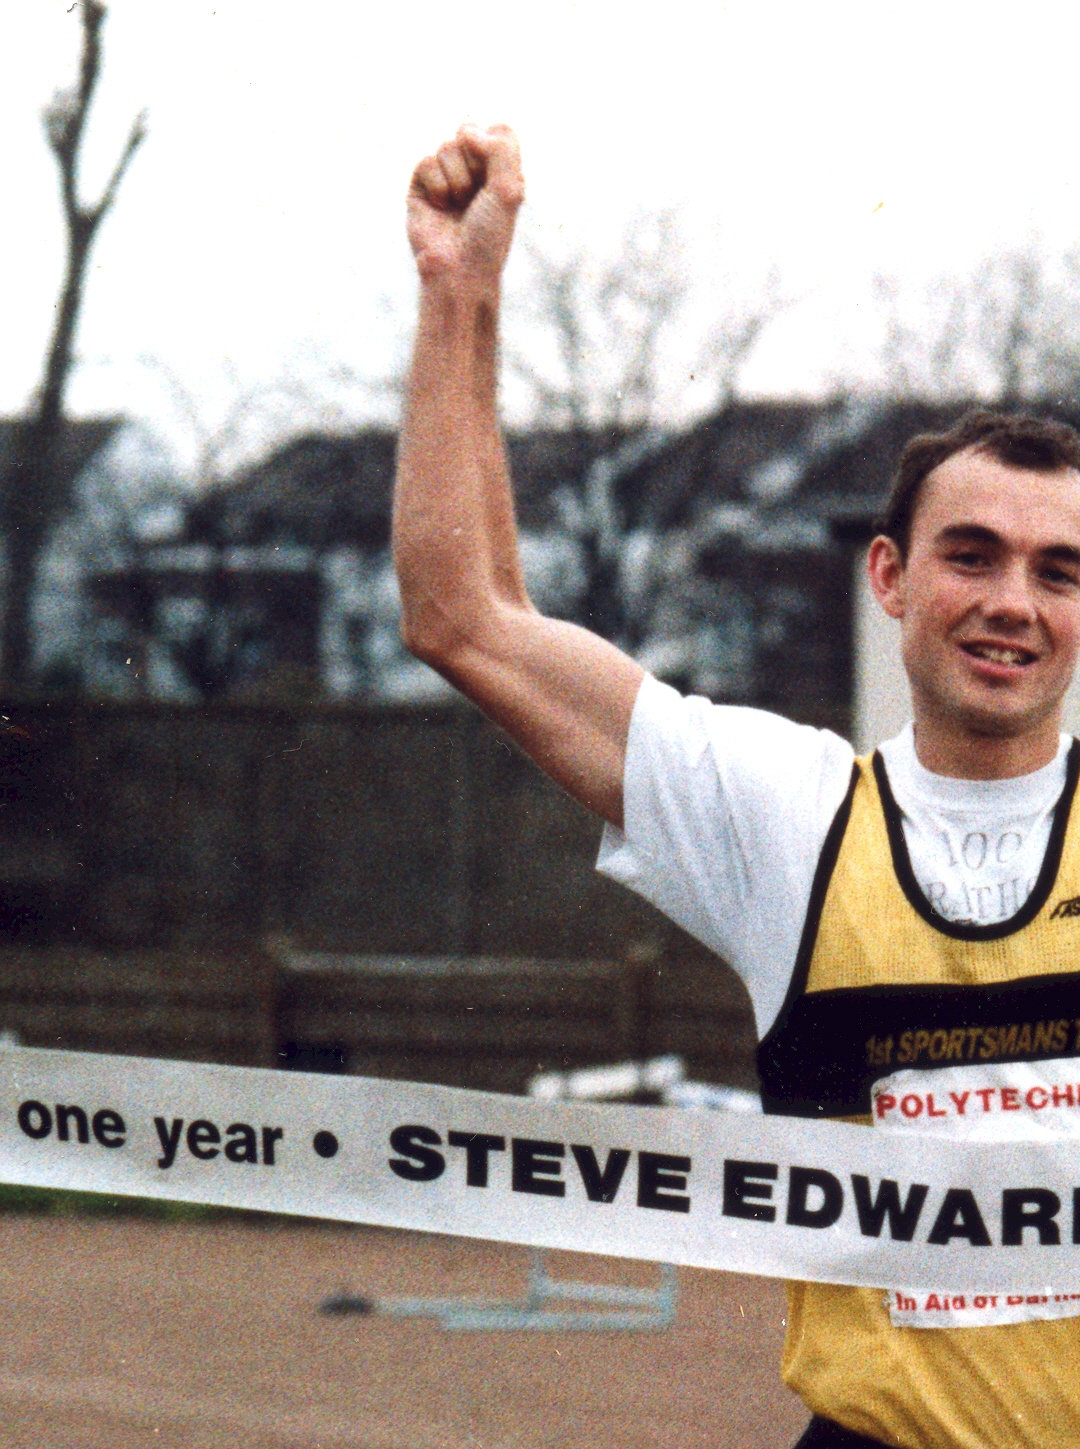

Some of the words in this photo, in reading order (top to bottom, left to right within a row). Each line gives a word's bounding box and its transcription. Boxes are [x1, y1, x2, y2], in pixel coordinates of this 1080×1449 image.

[866, 1035, 894, 1065] 1st
[897, 1019, 1070, 1061] SPORTSMANS
[18, 1100, 126, 1149] one
[154, 1116, 284, 1169] year
[388, 1125, 692, 1214] STEVE
[896, 1293, 917, 1311] In
[925, 1294, 966, 1311] Aid
